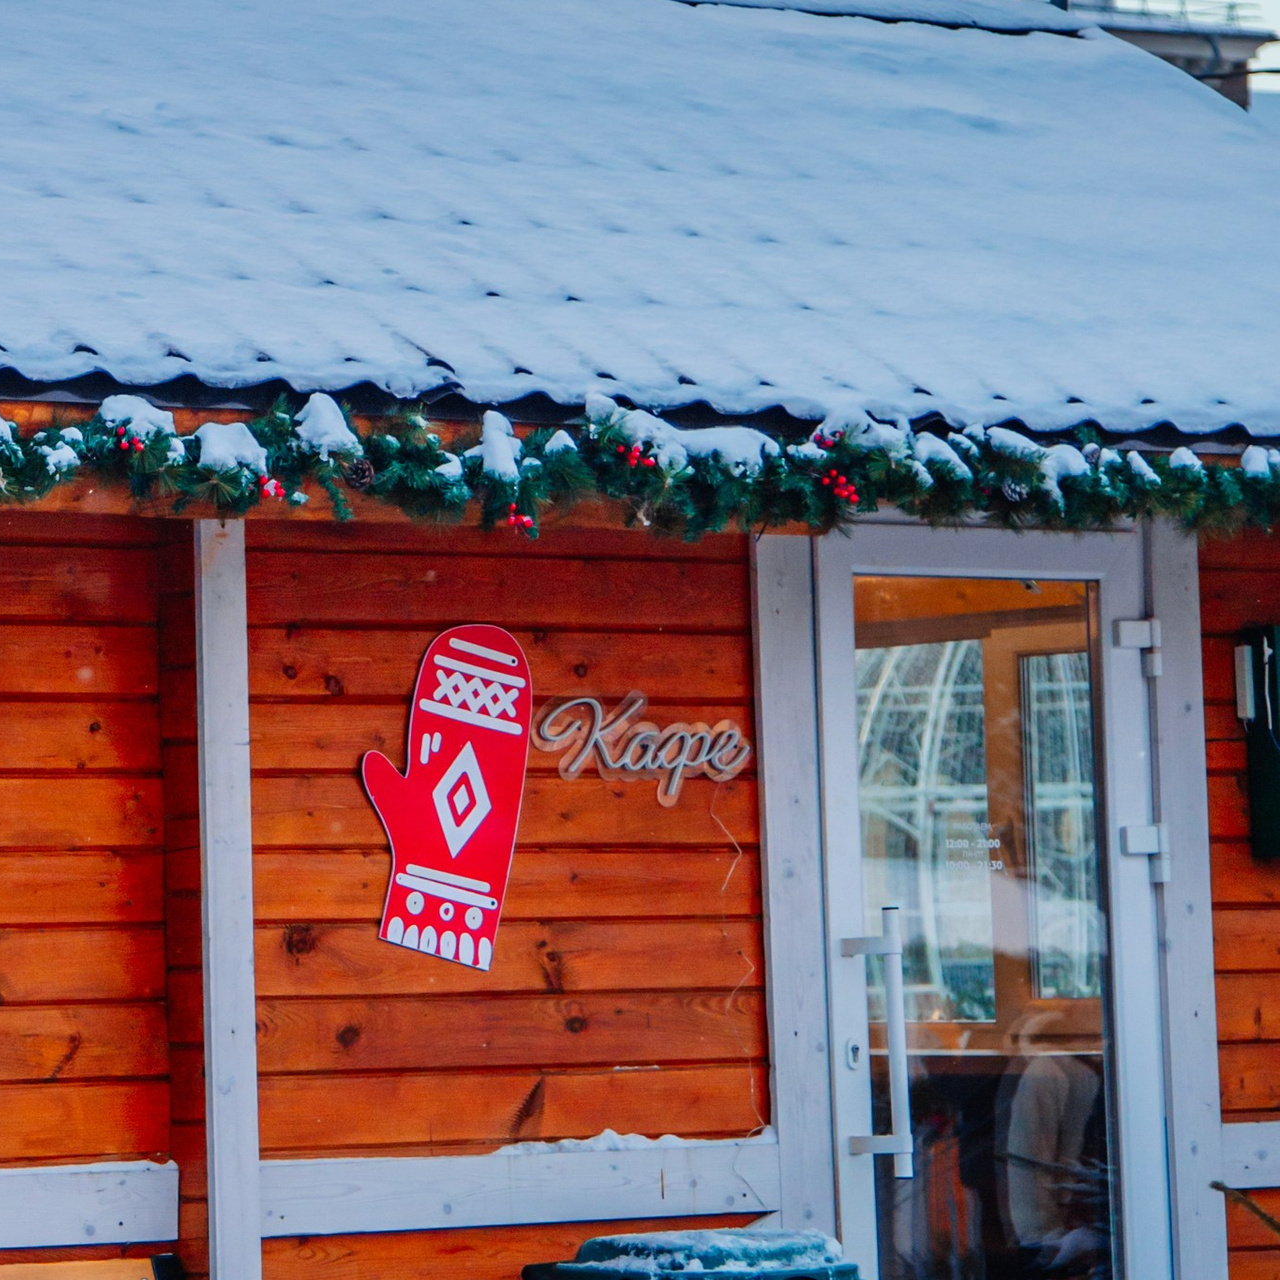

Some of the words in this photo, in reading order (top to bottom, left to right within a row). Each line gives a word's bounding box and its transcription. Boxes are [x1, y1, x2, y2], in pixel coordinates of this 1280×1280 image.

[945, 838, 969, 848] 12:00
[976, 838, 1001, 848] 21:00
[977, 860, 1003, 870] 21:30
